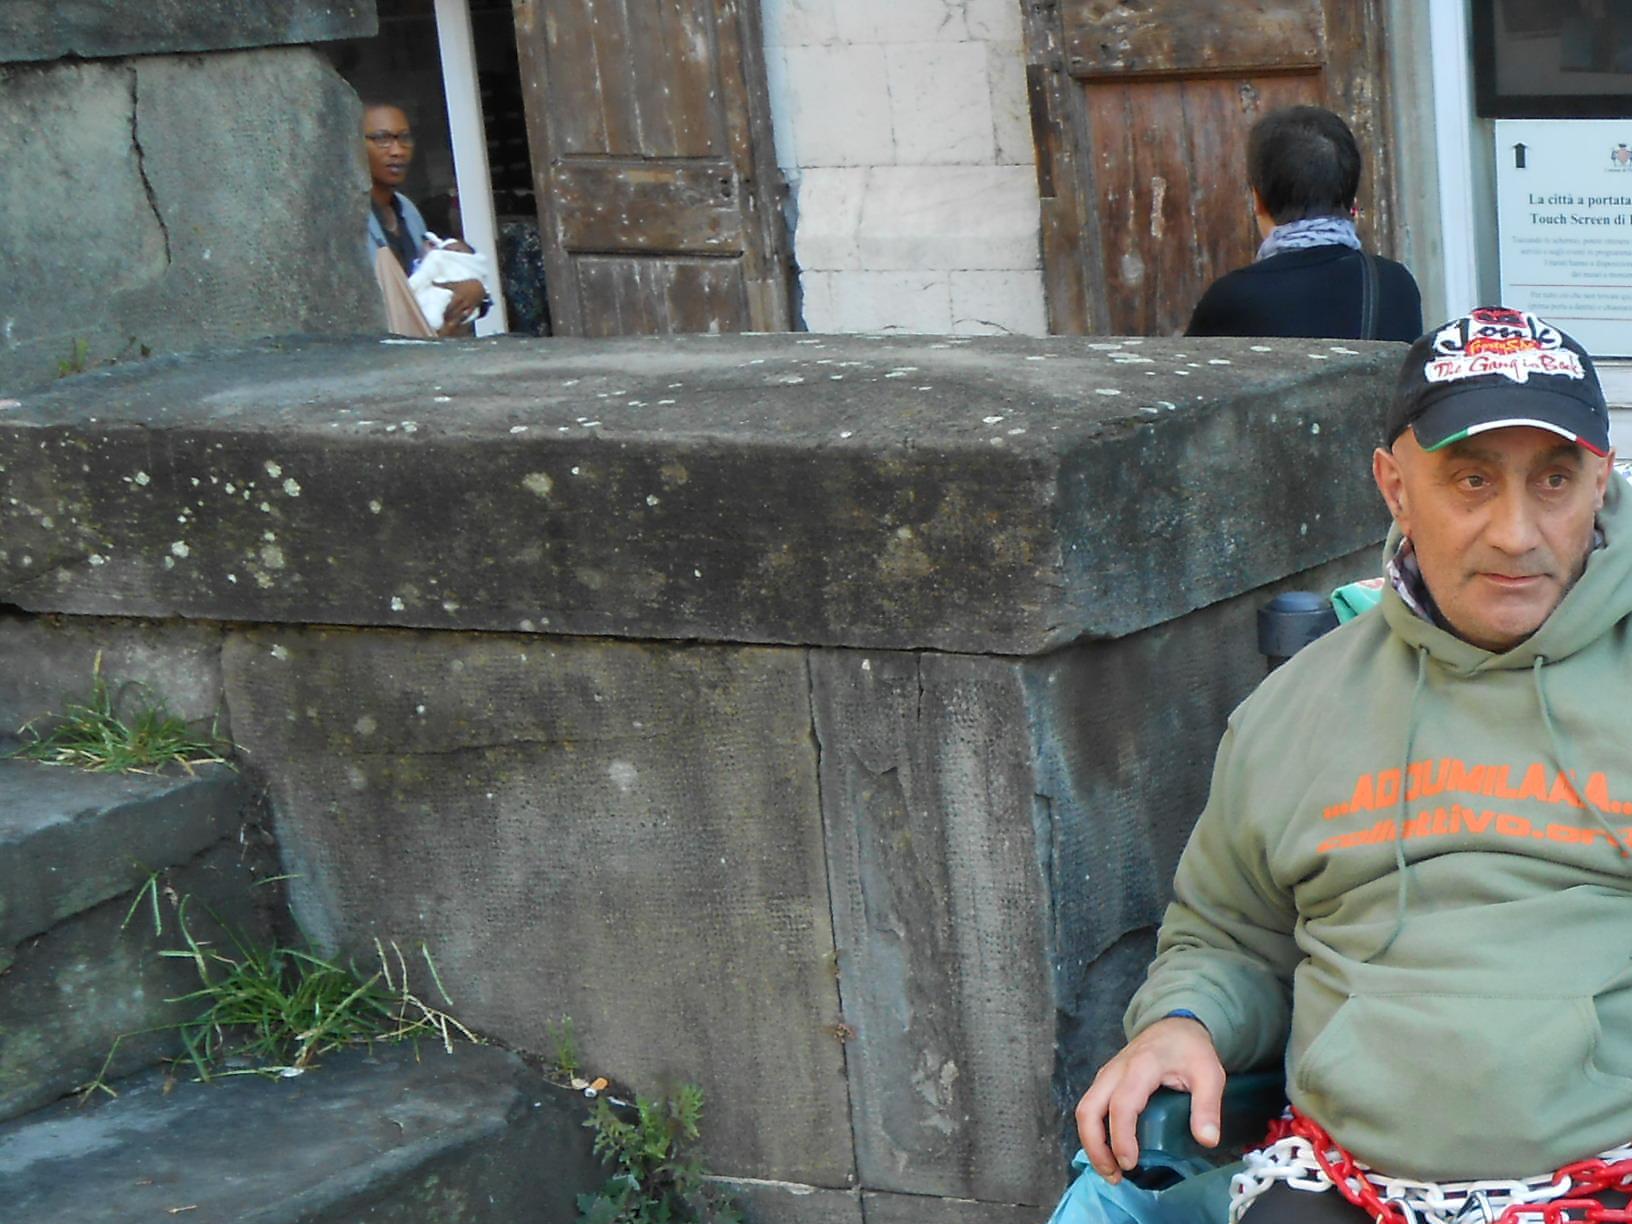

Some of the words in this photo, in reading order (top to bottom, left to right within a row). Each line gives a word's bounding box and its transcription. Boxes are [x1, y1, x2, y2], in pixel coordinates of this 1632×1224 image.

[1529, 193, 1544, 205] La
[1547, 193, 1574, 205] città
[1577, 196, 1584, 205] a
[1587, 195, 1632, 209] portata
[1530, 212, 1567, 224] Touch
[1570, 213, 1610, 225] Screen
[1613, 213, 1625, 225] di
[1434, 361, 1462, 378] The
[1469, 356, 1521, 380] Gang
